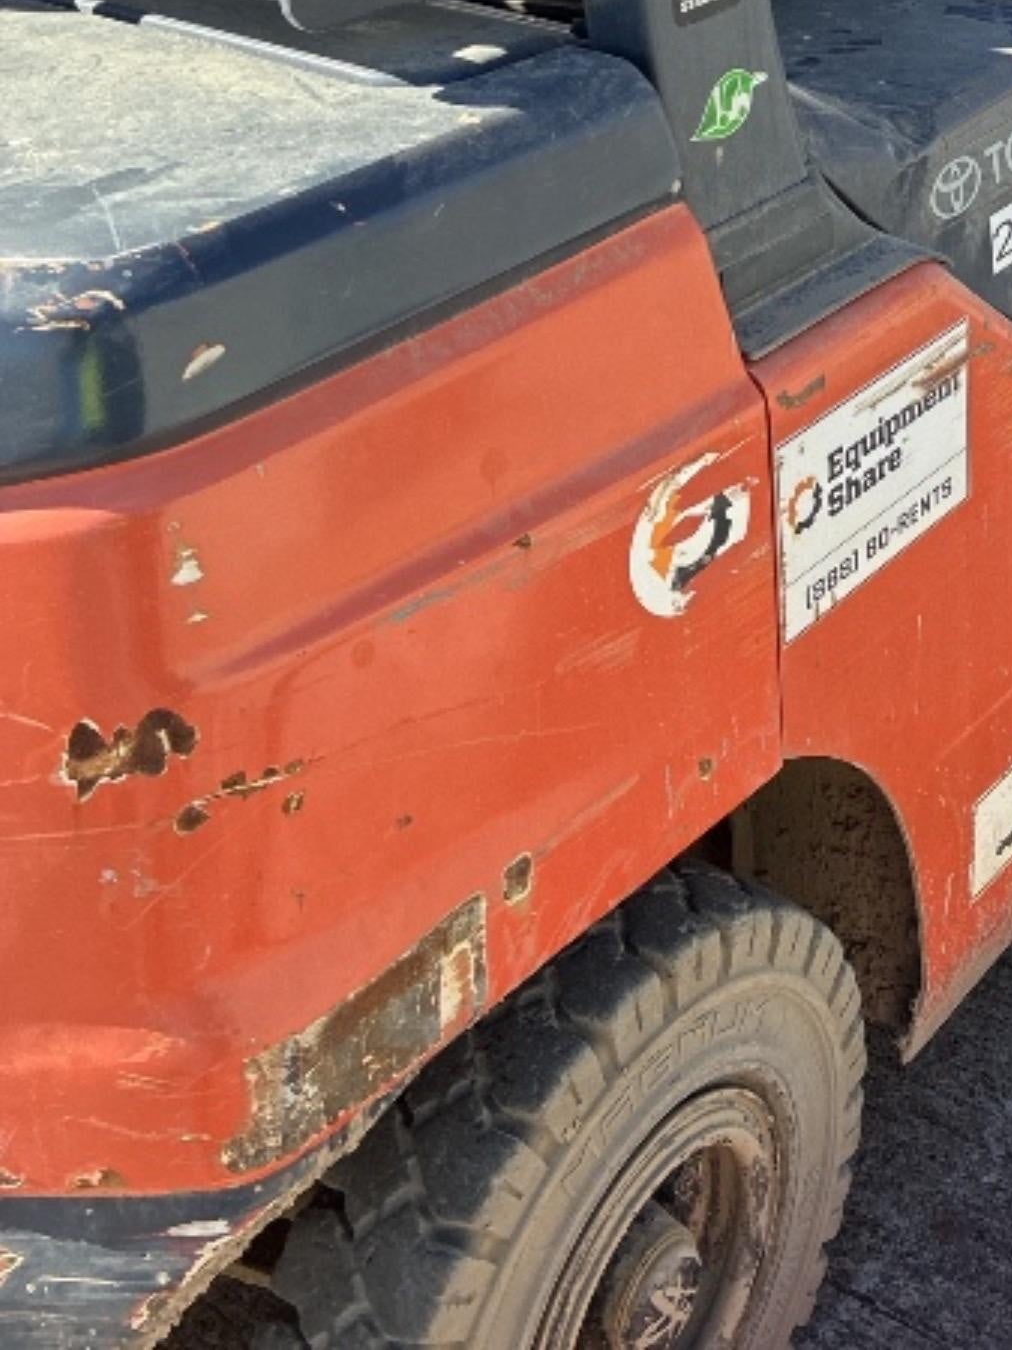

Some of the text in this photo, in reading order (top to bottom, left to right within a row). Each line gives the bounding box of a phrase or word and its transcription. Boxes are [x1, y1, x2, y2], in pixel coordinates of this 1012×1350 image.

[826, 371, 961, 483] Equipment
[826, 446, 902, 517] Share
[805, 476, 952, 610] (888) 80-RENTS
